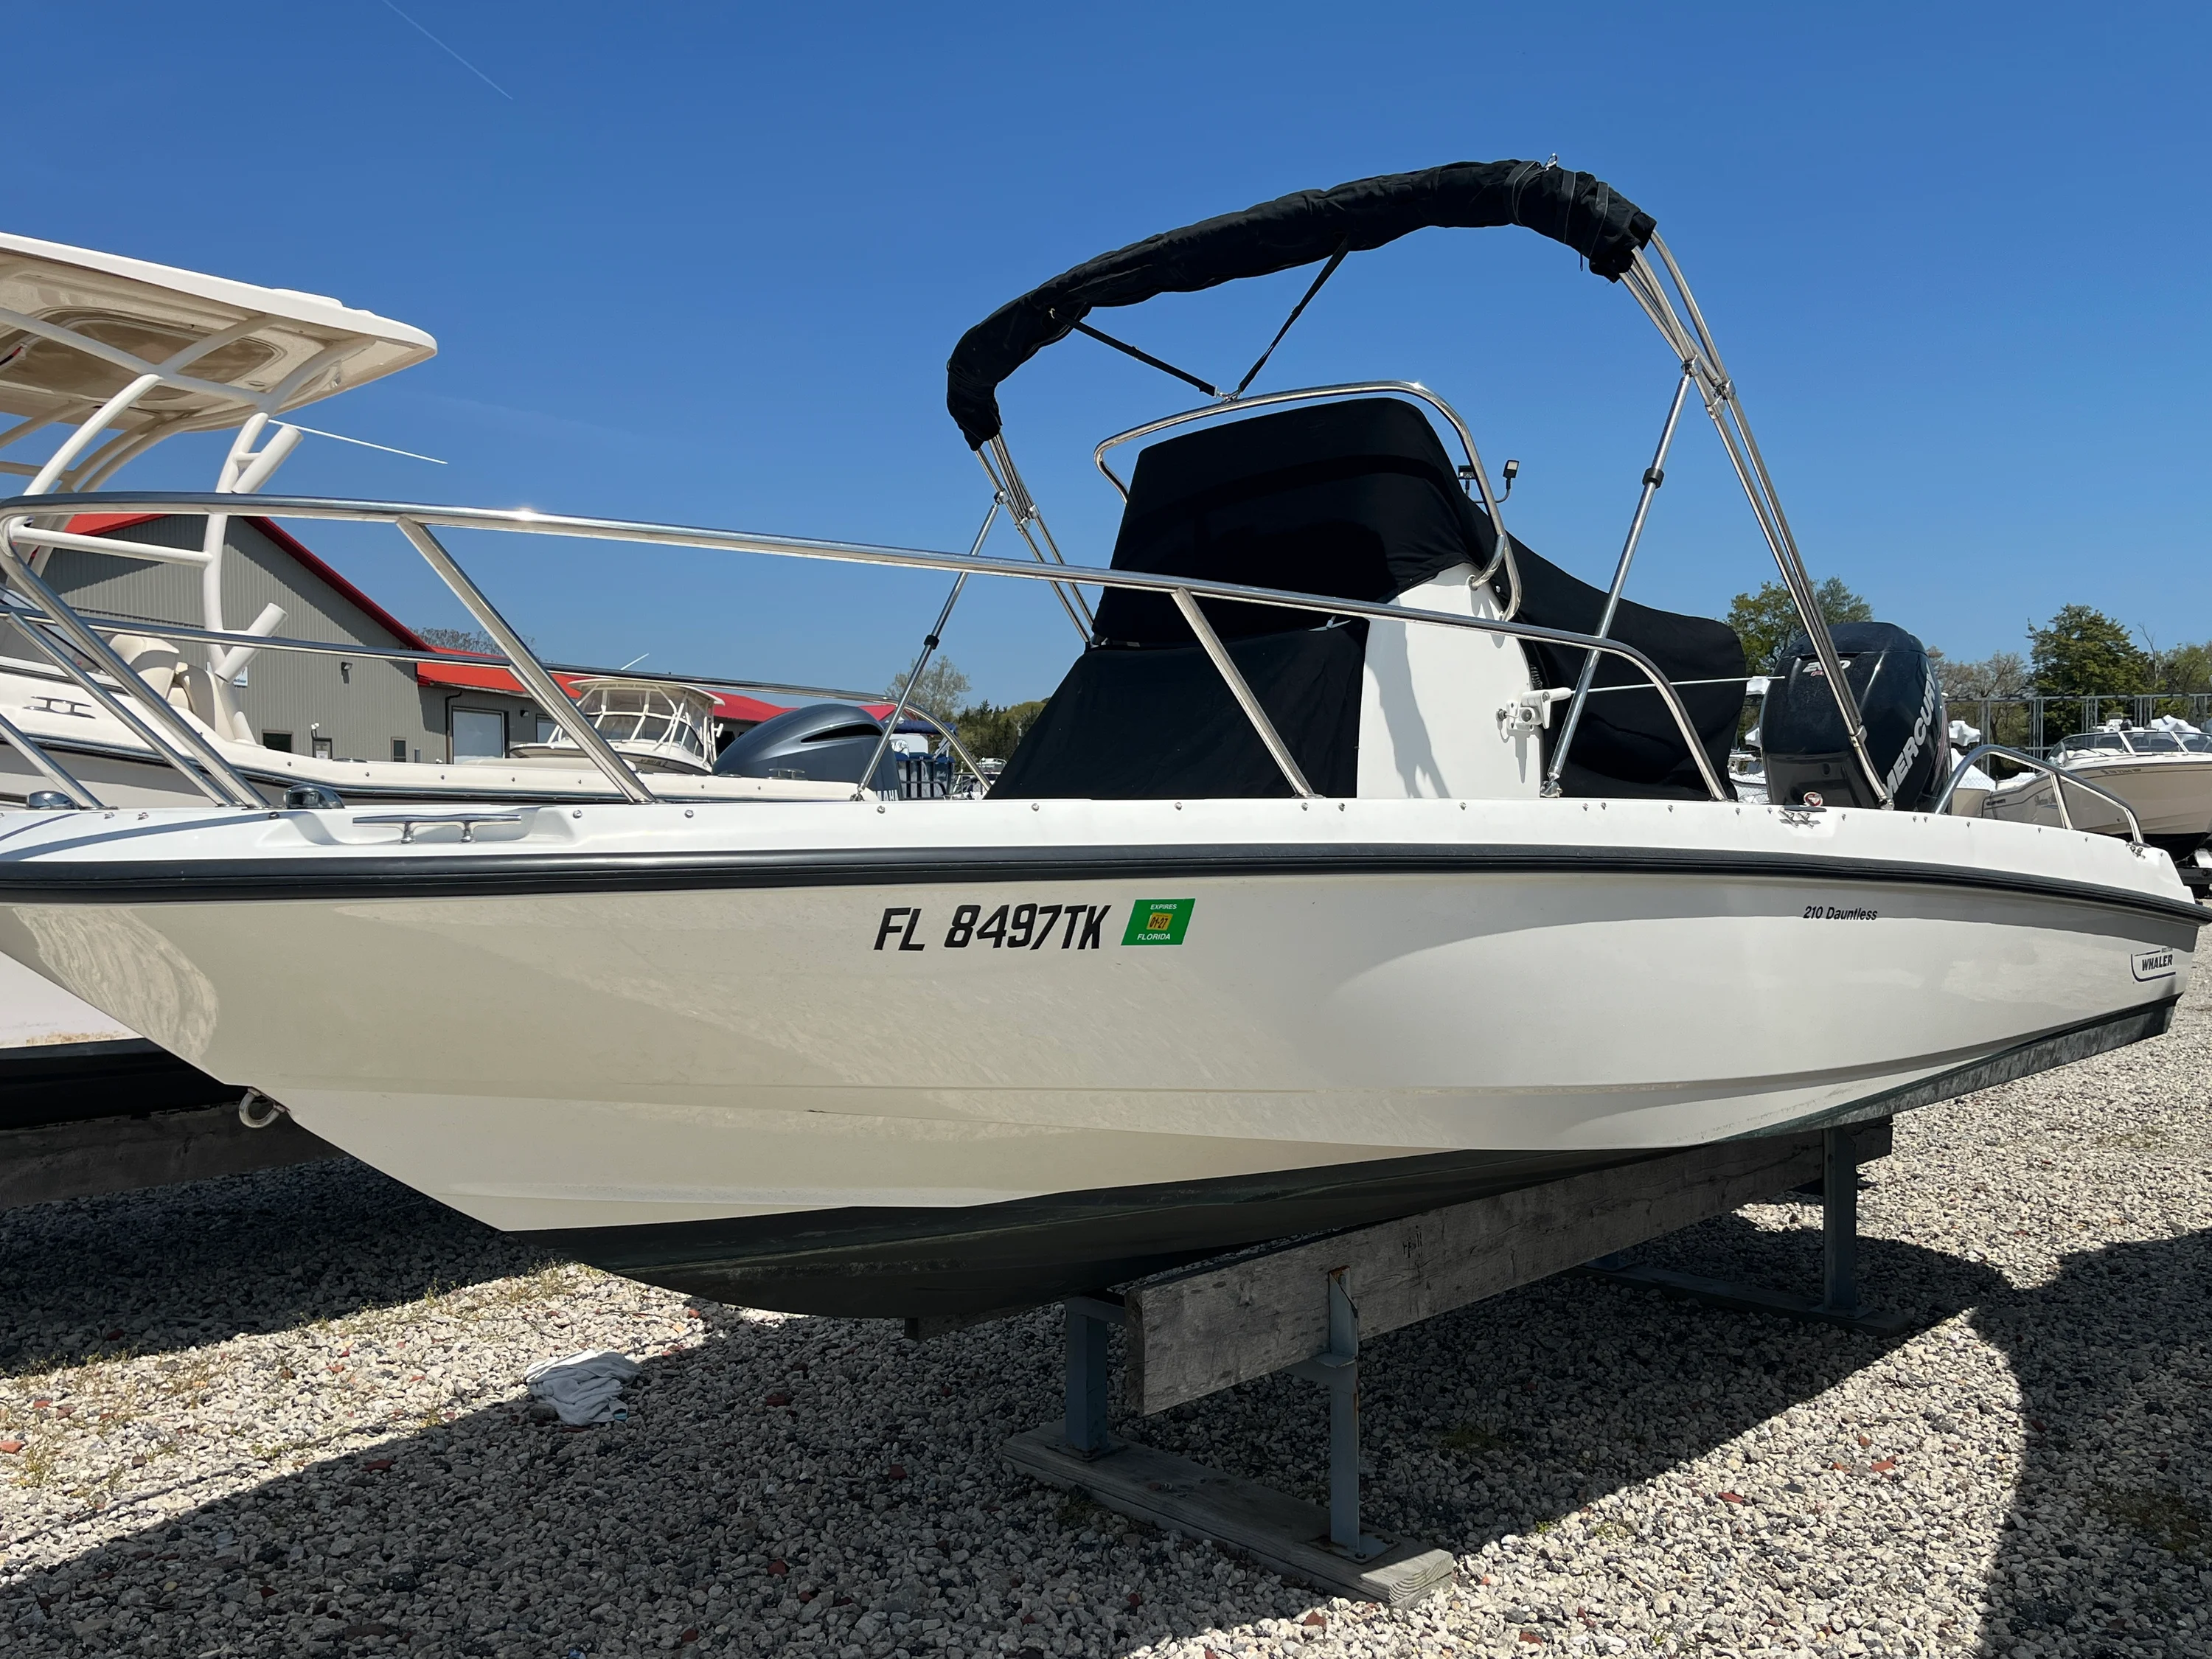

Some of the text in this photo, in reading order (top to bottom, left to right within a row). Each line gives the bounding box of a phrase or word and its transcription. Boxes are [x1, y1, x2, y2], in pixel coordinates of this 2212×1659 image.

[1886, 661, 1936, 799] MERCURY
[1803, 905, 1878, 921] 210 Dauntless
[873, 903, 1113, 951] FL 8497TK
[1149, 916, 1169, 930] 01-27
[1136, 933, 1171, 941] FLORIDA
[2142, 953, 2173, 972] WHALER
